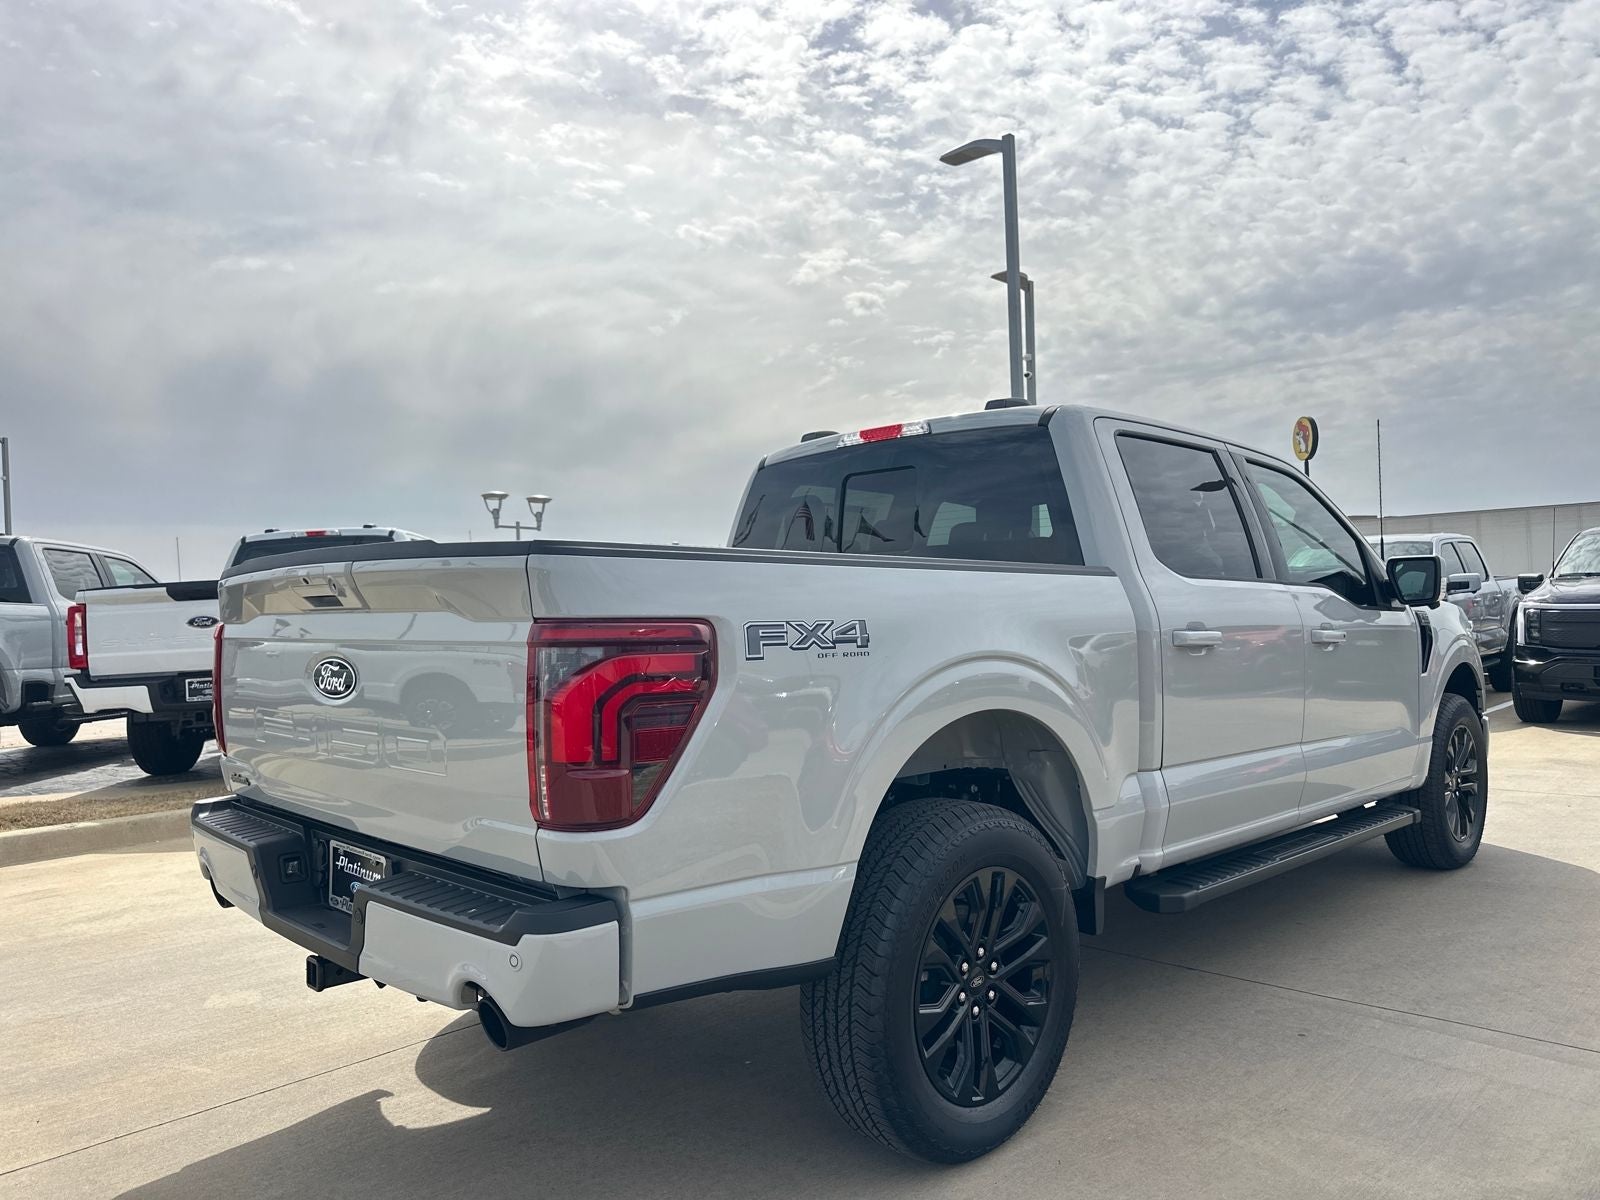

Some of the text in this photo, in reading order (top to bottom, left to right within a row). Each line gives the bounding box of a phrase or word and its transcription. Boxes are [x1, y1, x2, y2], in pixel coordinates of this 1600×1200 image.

[743, 620, 870, 660] FX4
[318, 663, 347, 691] Ford
[335, 855, 382, 881] Platinum
